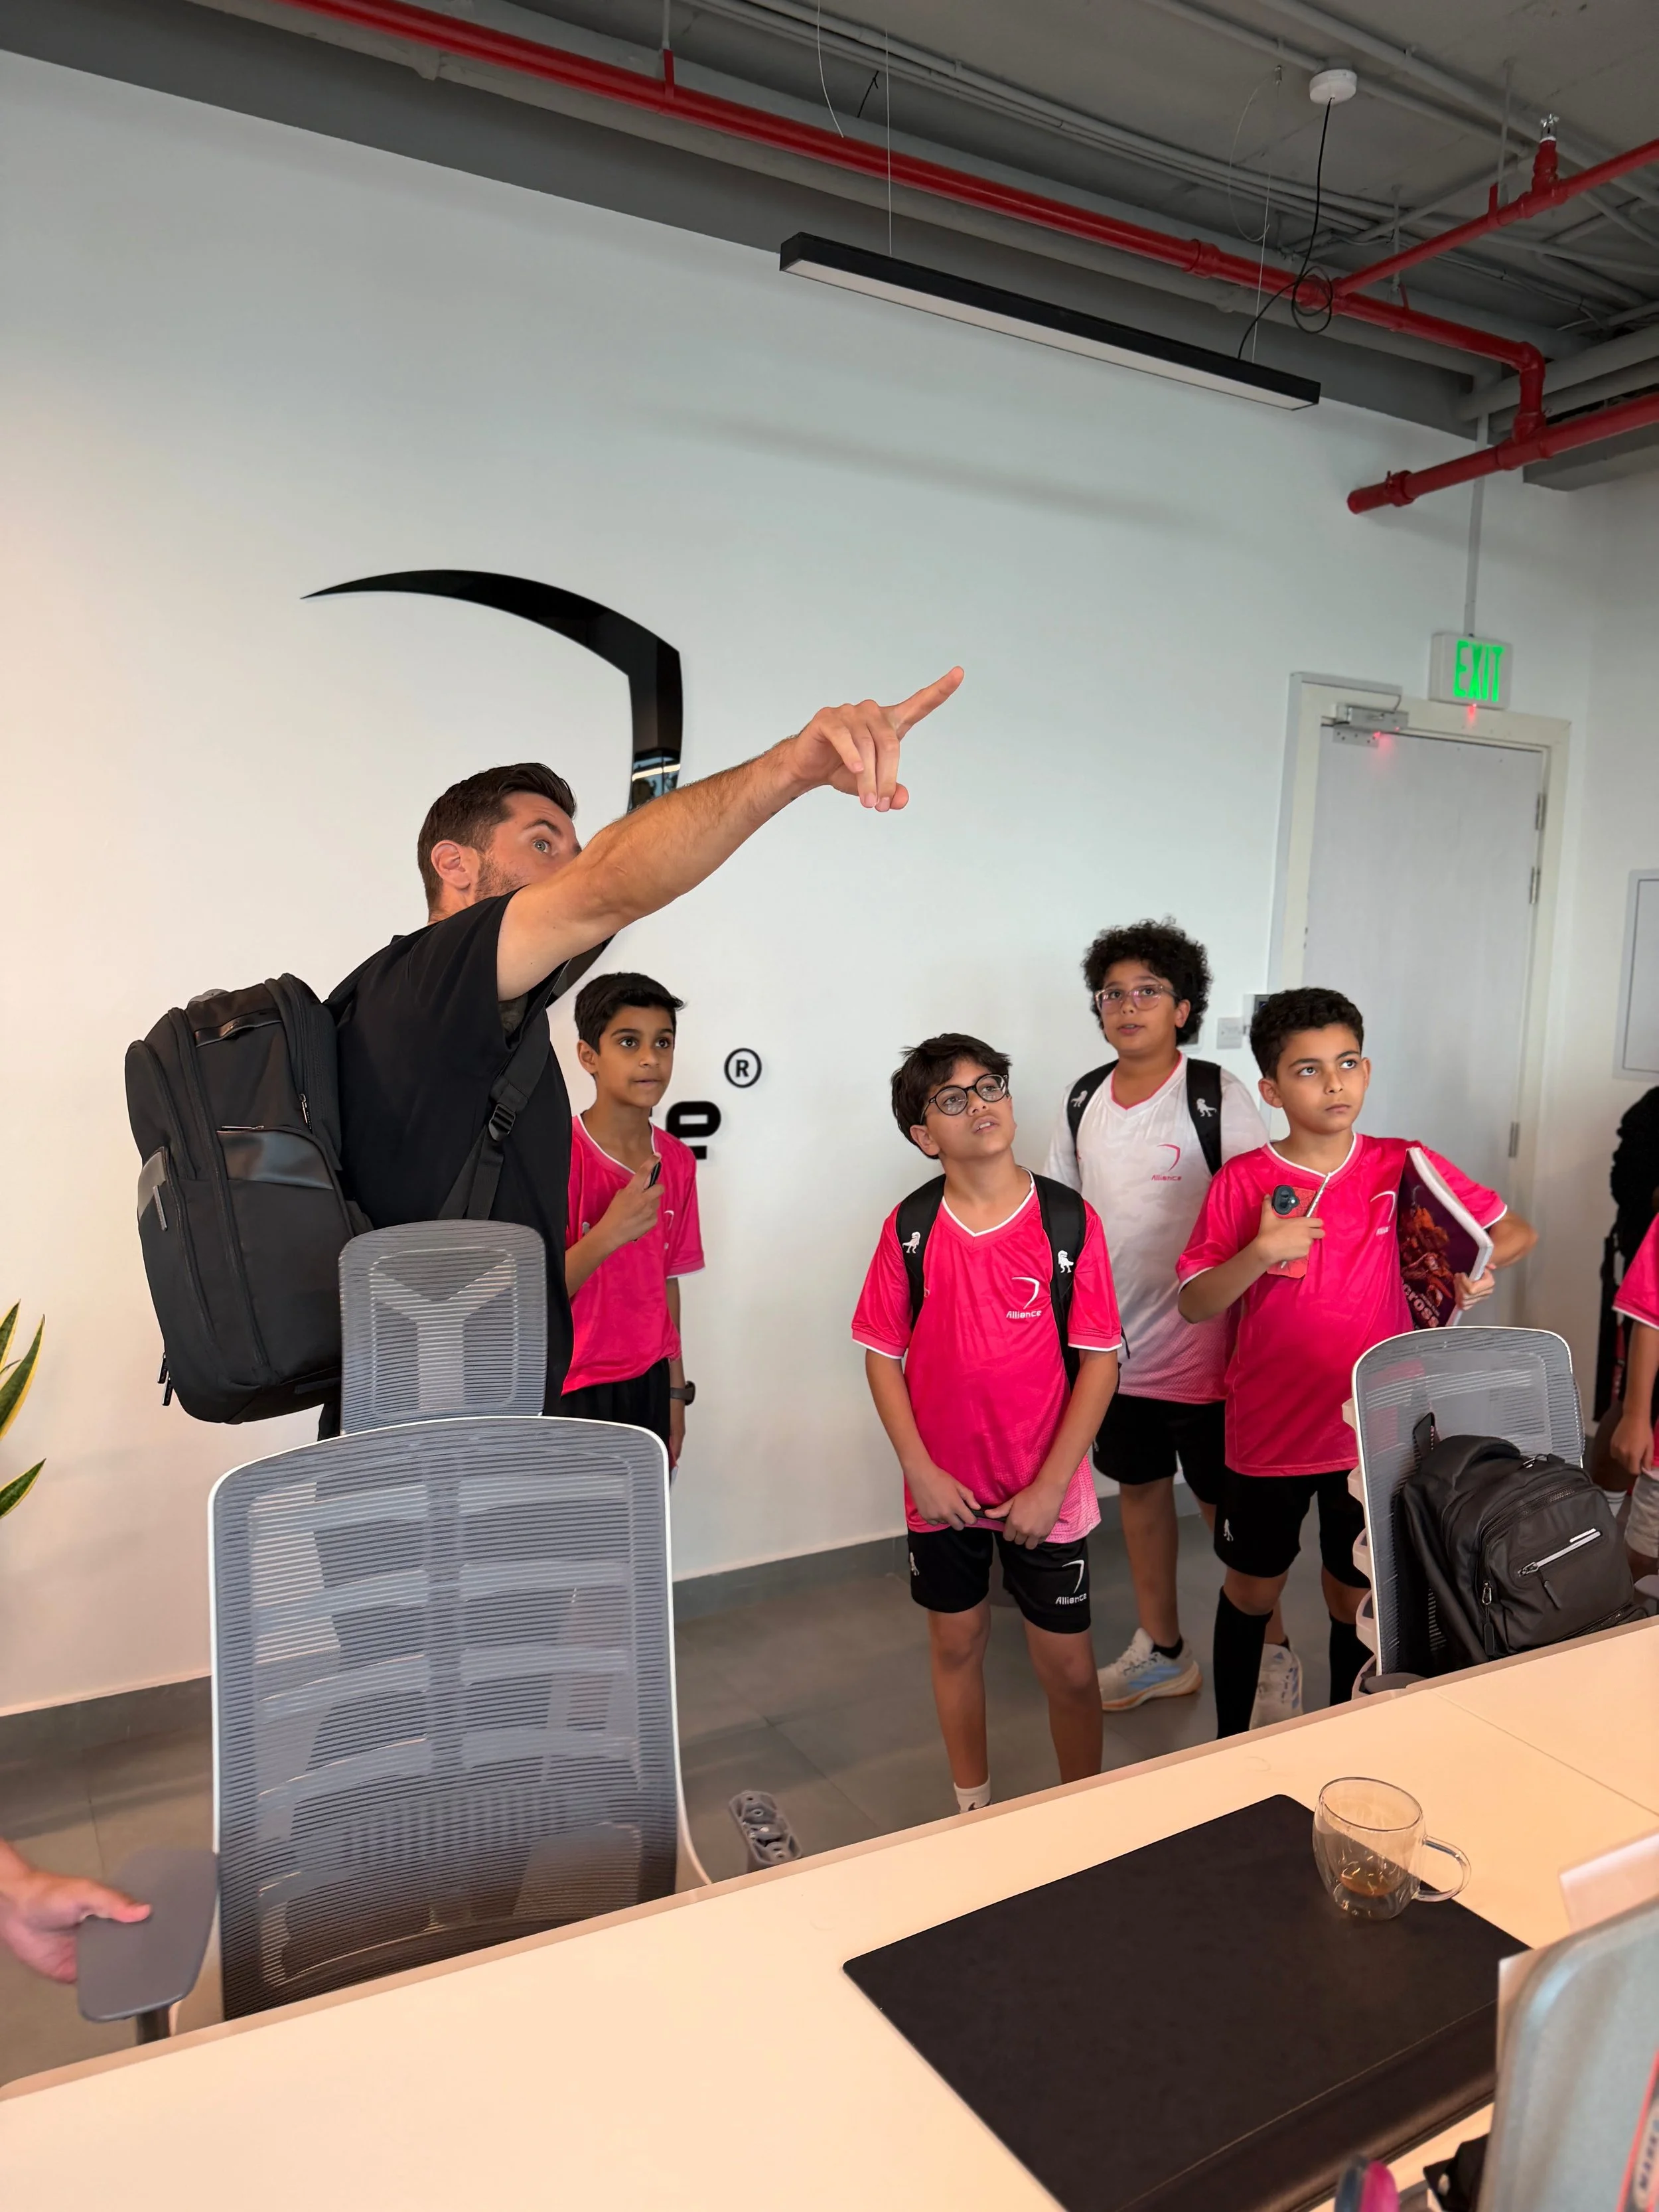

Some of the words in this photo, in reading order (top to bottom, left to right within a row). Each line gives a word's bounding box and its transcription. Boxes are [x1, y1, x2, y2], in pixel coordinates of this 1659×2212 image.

[1453, 639, 1504, 702] EXIT
[1005, 1310, 1043, 1319] Alliance
[1055, 1593, 1087, 1605] Alliance
